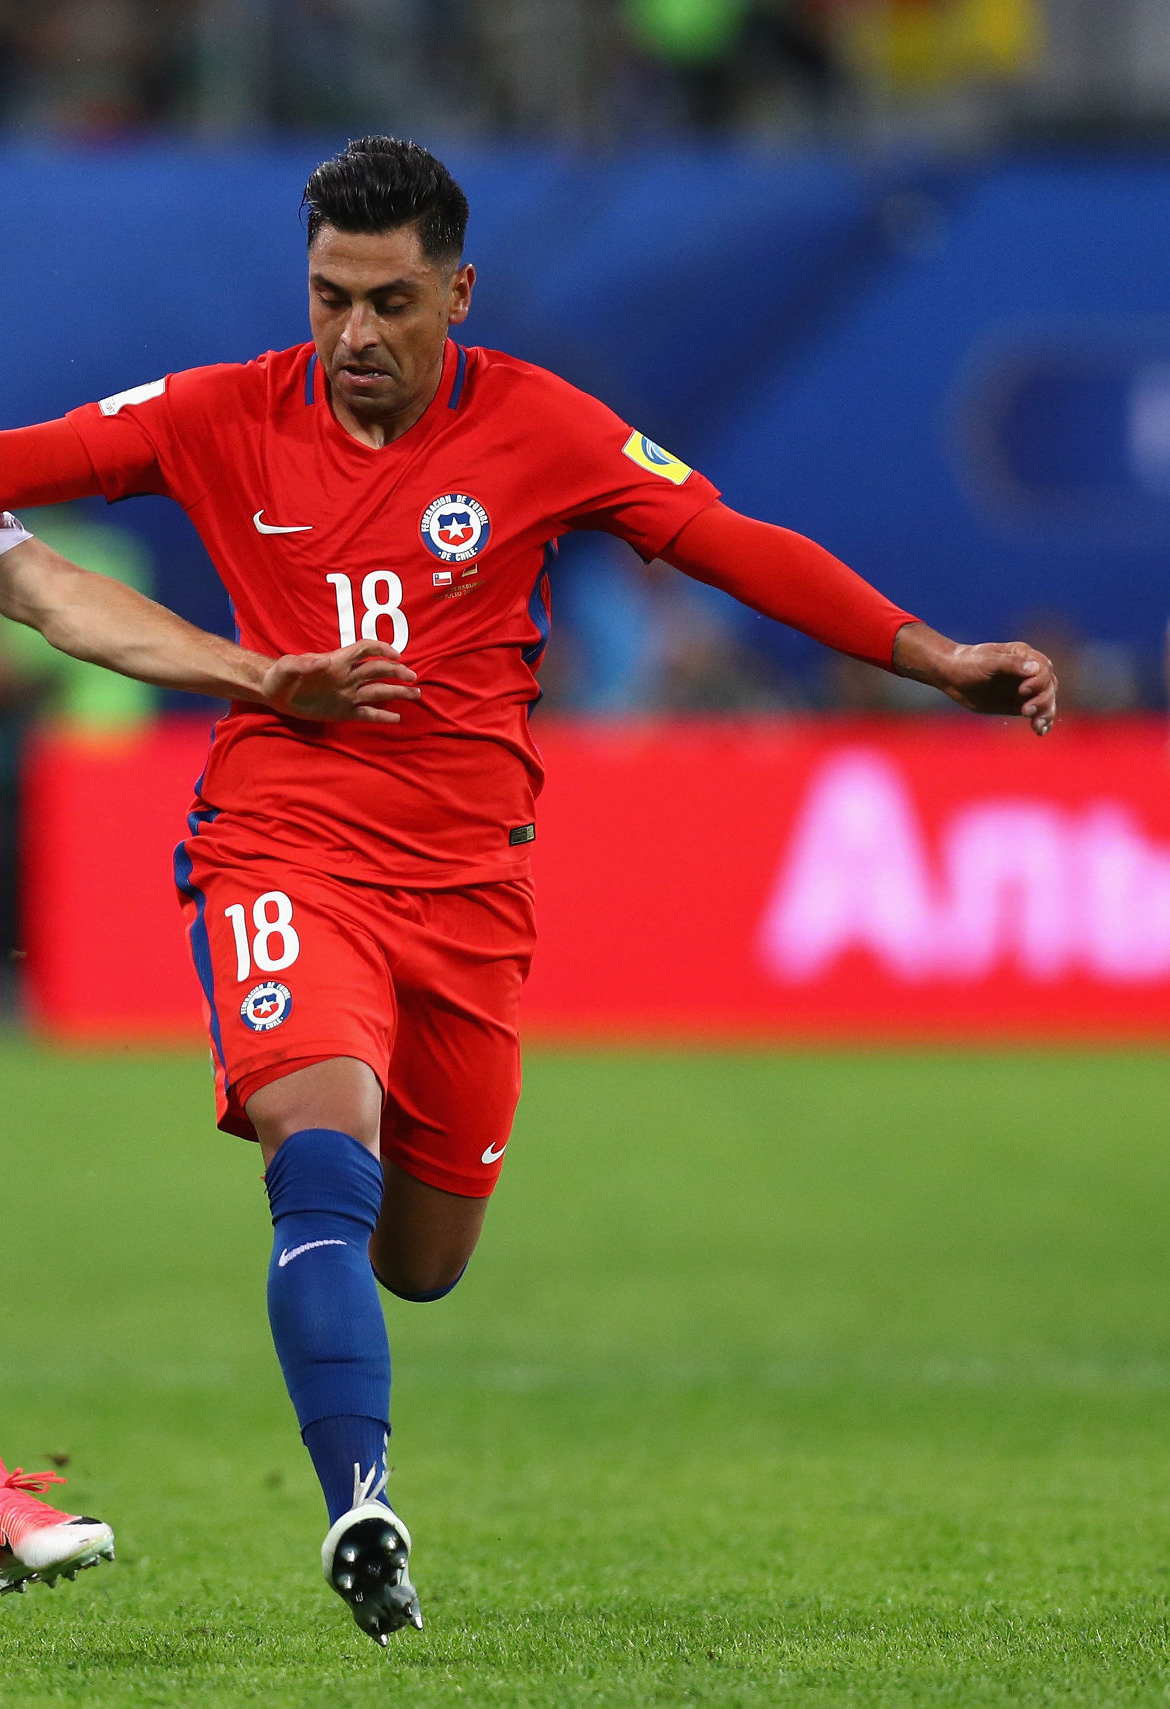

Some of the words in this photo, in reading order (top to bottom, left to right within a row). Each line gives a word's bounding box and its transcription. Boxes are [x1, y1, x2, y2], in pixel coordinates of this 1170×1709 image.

[421, 494, 452, 533] FEDERACION
[456, 494, 468, 503] DE
[468, 499, 489, 526] FUTBOL
[440, 552, 451, 561] DE
[455, 548, 477, 562] CHILE
[326, 570, 409, 654] 18
[224, 890, 301, 983] 18
